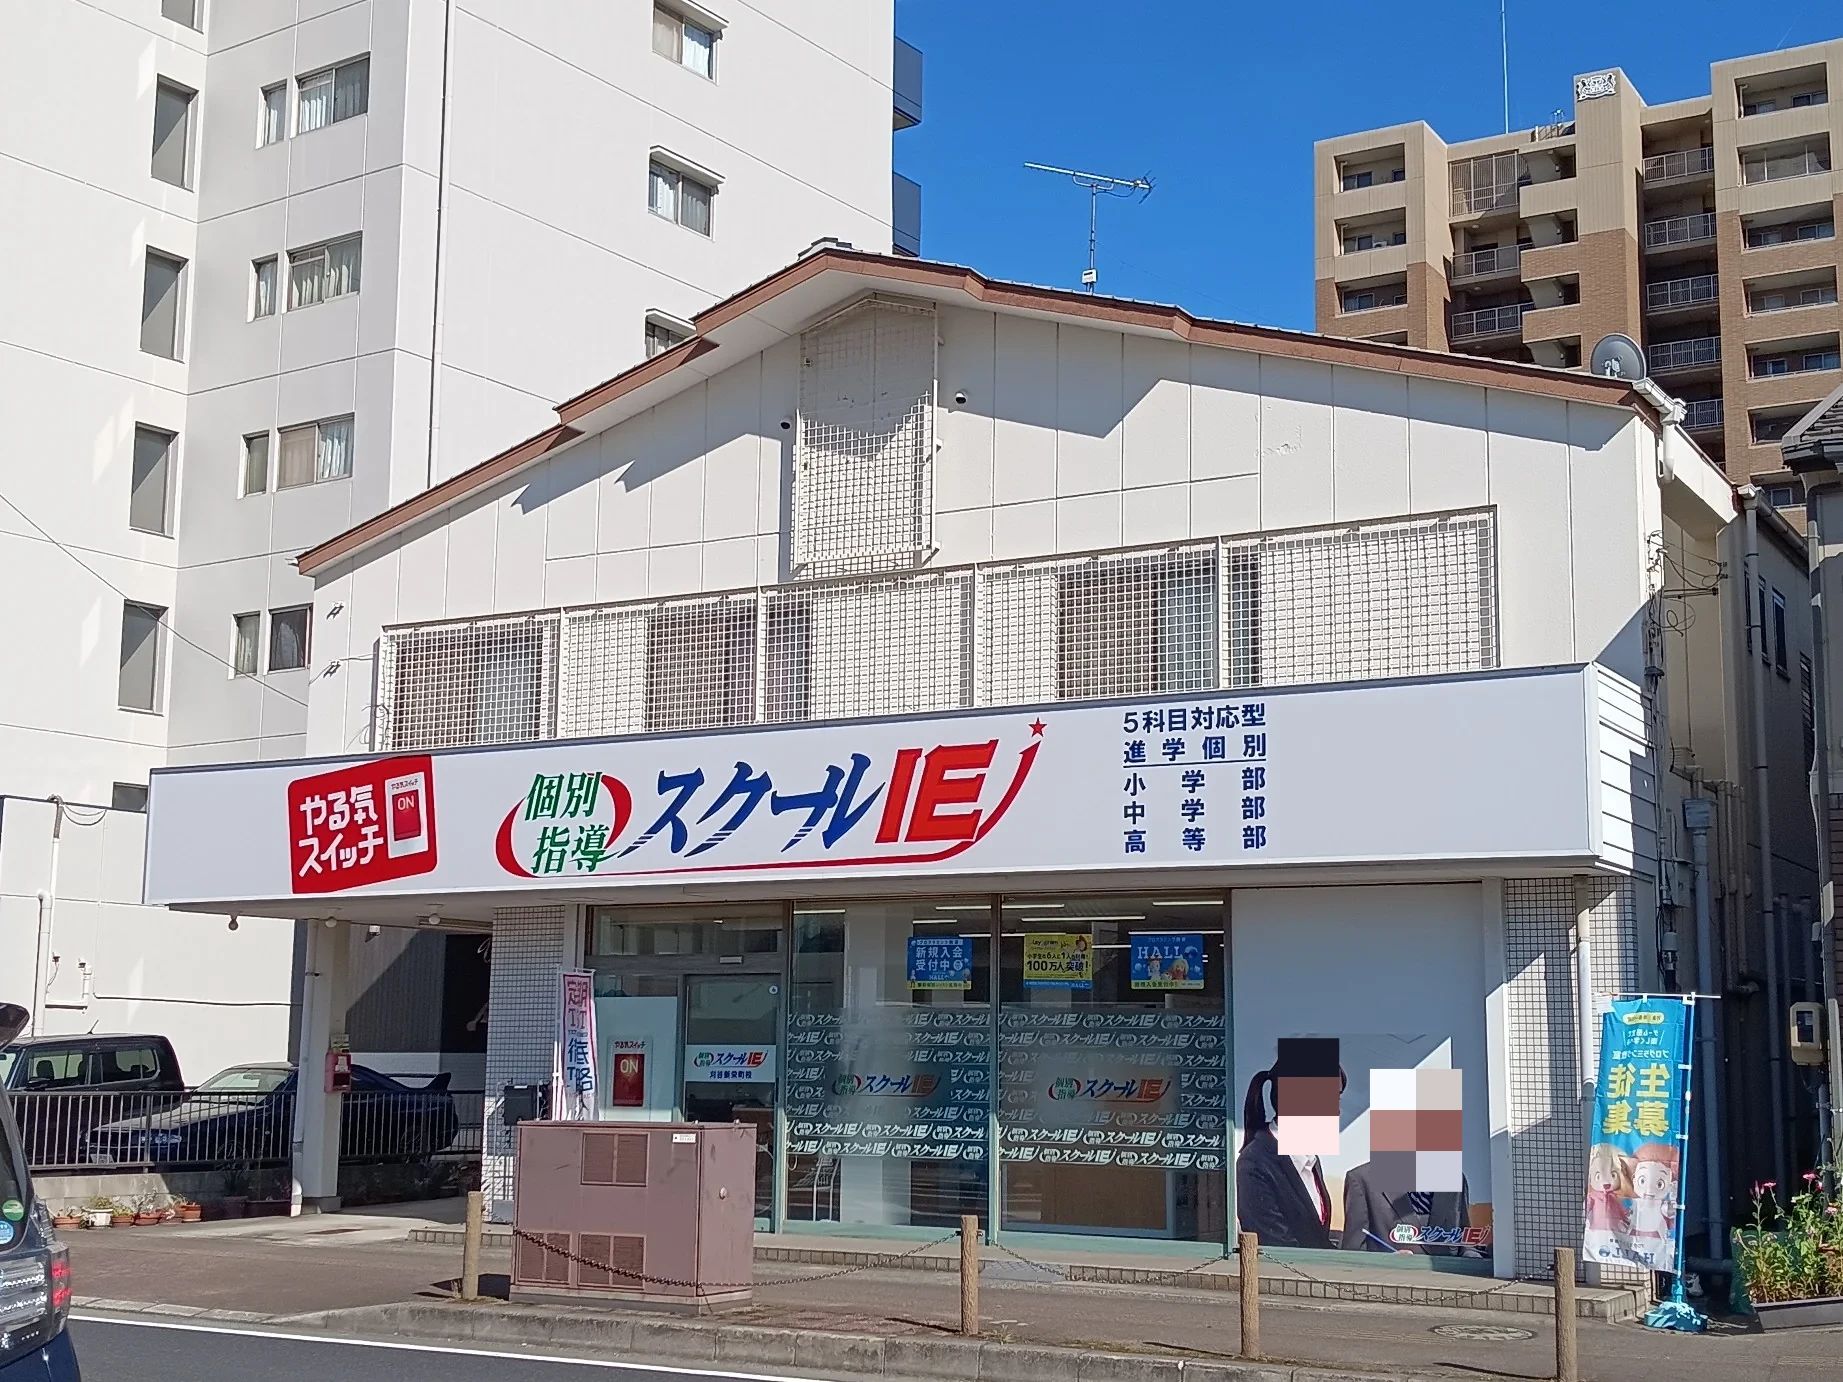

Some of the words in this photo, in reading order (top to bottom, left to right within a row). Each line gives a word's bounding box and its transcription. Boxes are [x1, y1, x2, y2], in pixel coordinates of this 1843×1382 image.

[1123, 702, 1266, 734] 5科目対応型
[299, 783, 379, 833] やる気
[398, 795, 415, 811] ON
[524, 770, 602, 821] 個別
[618, 738, 1000, 858] スクールIE
[298, 825, 386, 878] スイッチ
[531, 825, 609, 876] 指導
[916, 946, 963, 958] 新規入会
[916, 959, 950, 971] 受付中
[620, 1059, 639, 1073] ON
[1416, 1226, 1483, 1245] スクールIE
